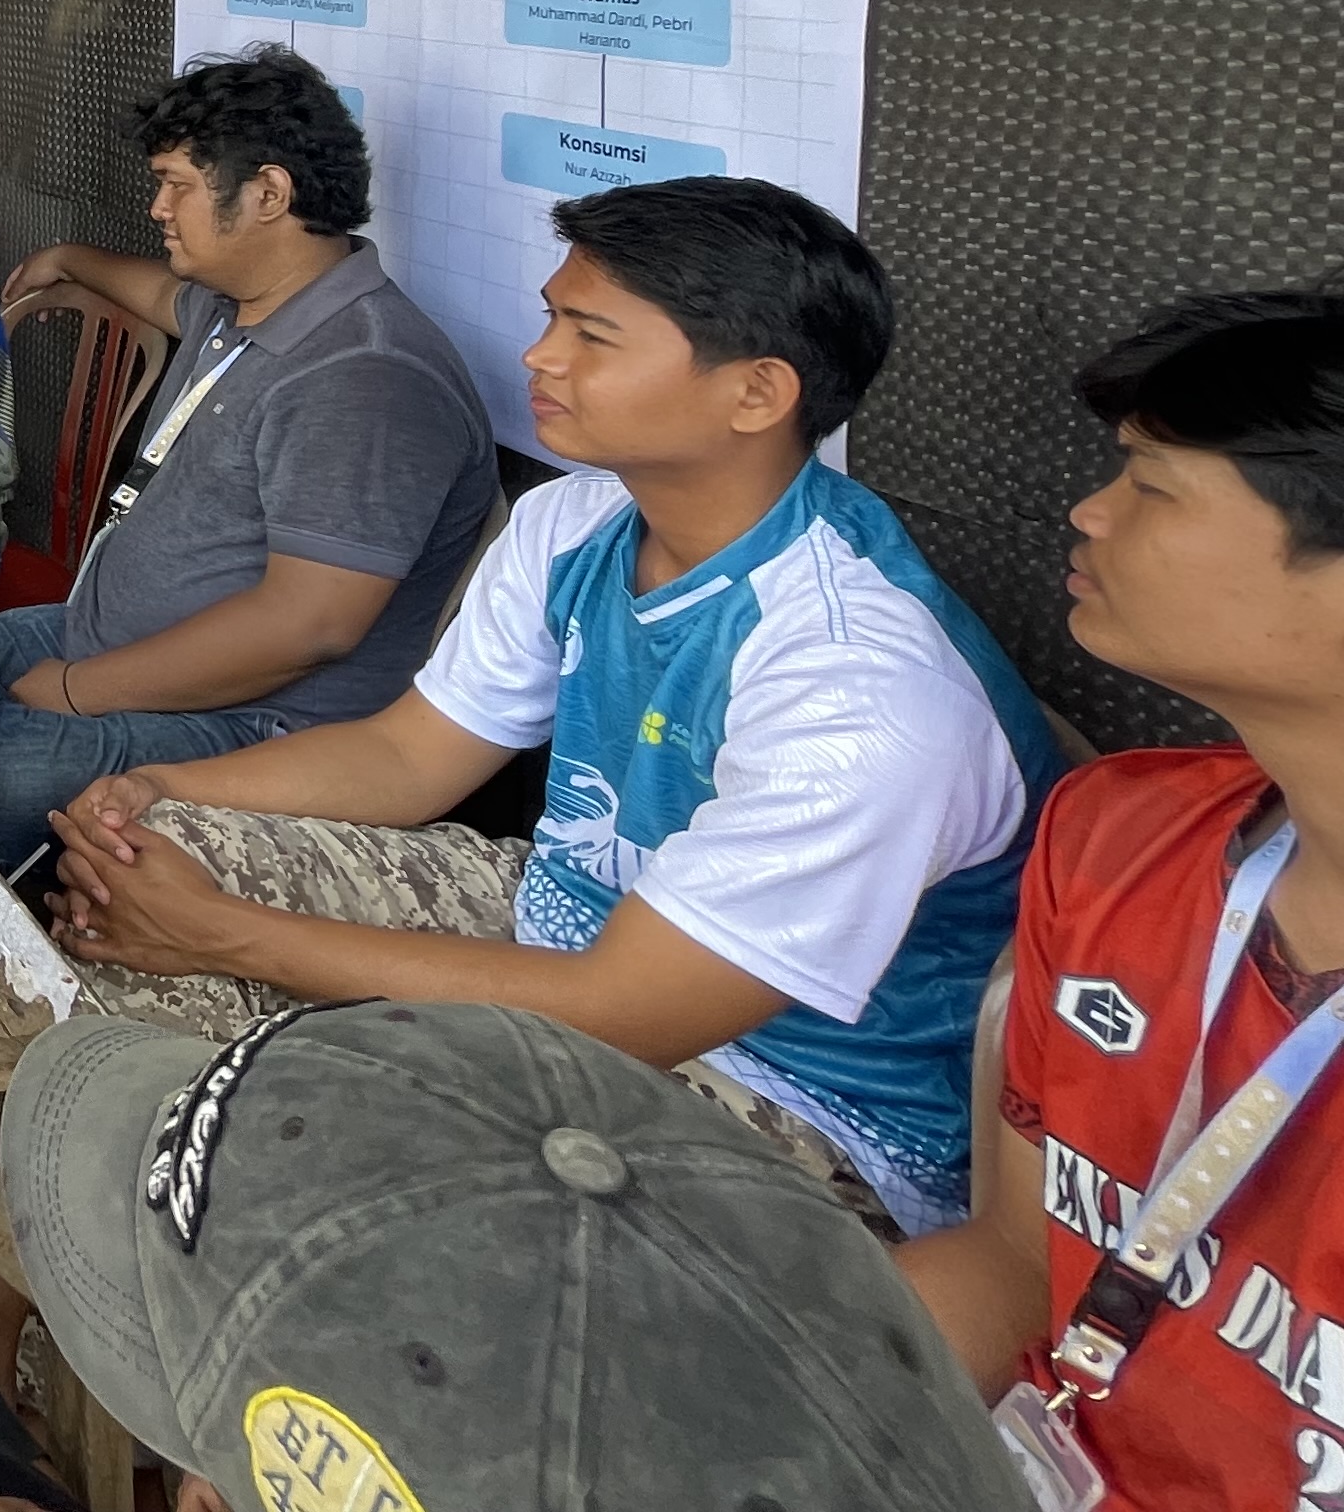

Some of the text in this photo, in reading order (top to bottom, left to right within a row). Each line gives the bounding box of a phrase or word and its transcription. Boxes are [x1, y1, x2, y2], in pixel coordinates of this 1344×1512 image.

[528, 5, 693, 32] Muhammad Dandi, Pebri
[559, 131, 647, 164] Konsumsi
[565, 160, 588, 178] Nur
